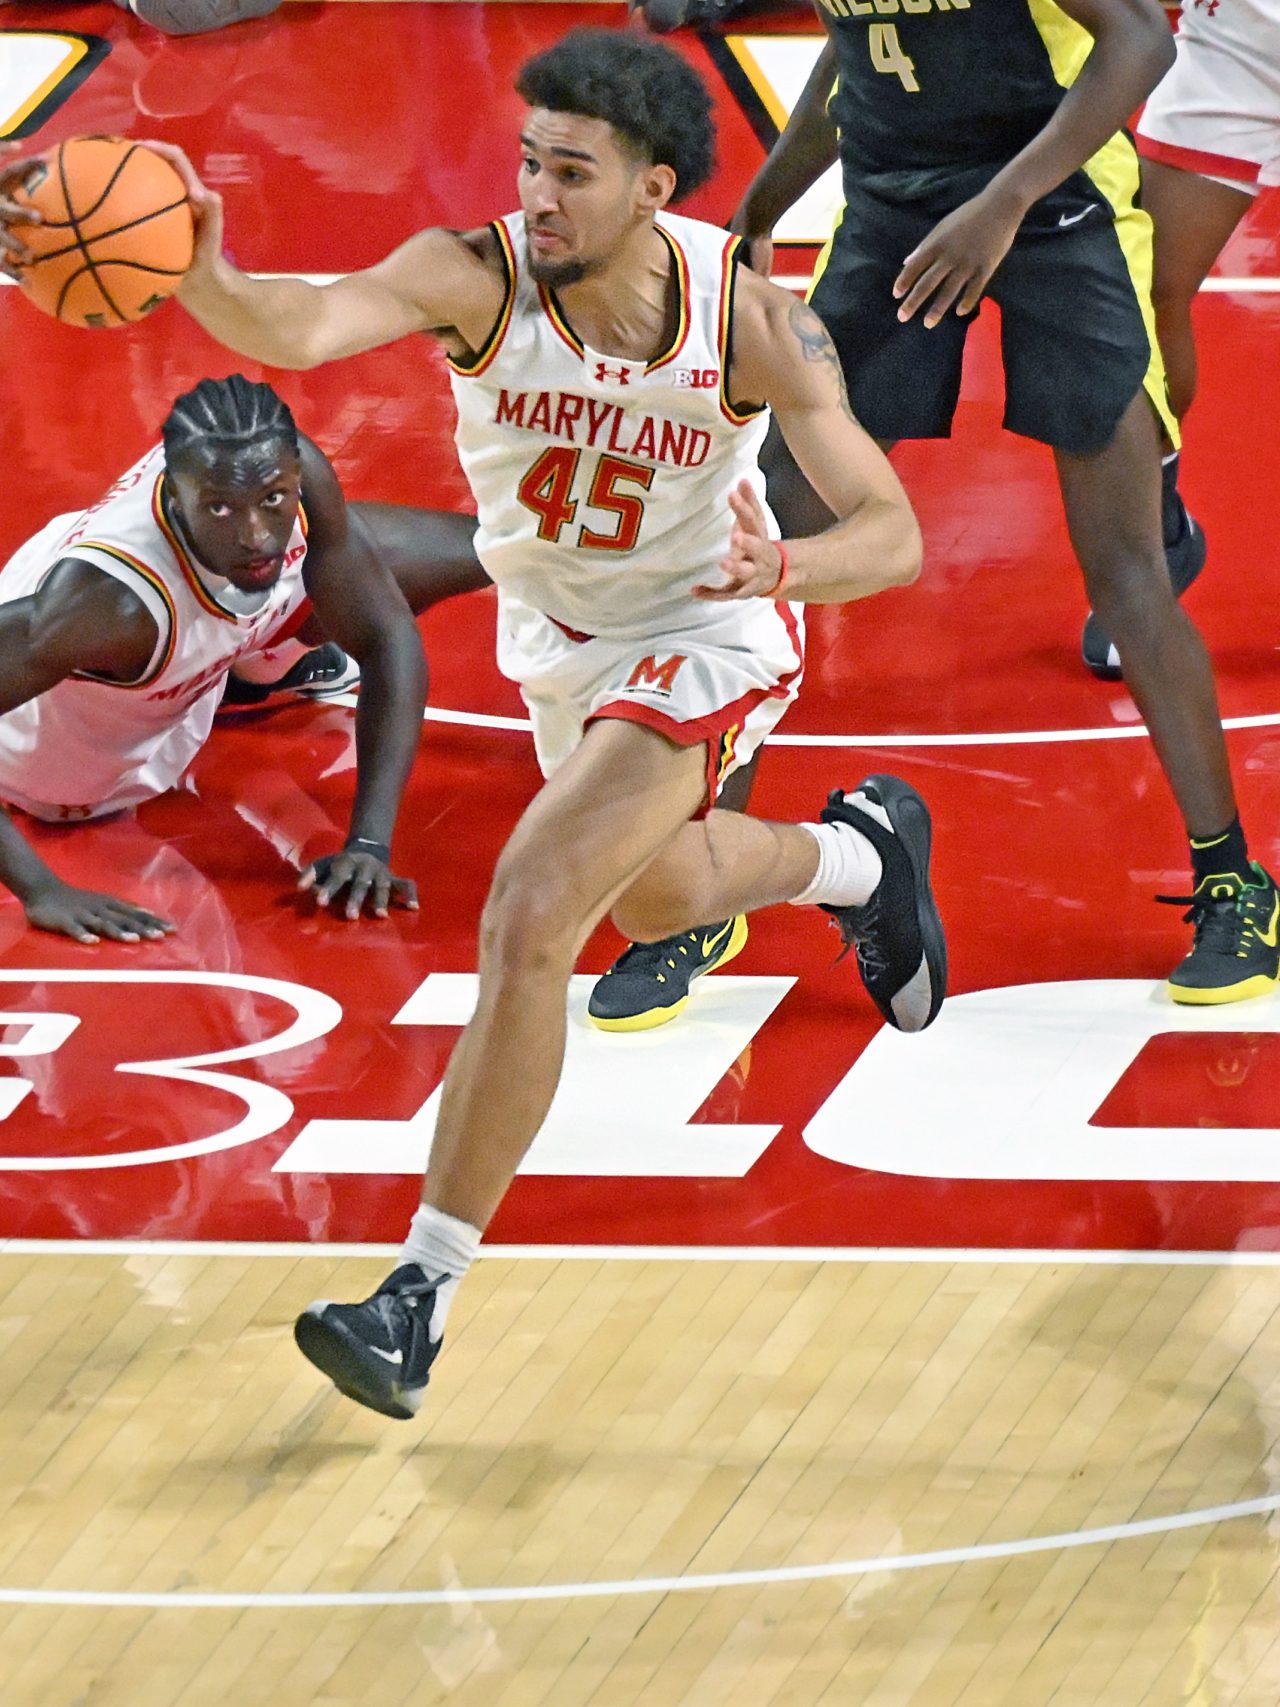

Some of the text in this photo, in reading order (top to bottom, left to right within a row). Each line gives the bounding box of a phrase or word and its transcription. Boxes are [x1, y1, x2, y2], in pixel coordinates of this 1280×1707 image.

[868, 23, 920, 92] 4
[494, 389, 711, 468] MARYLAND
[517, 446, 655, 552] 45
[624, 654, 688, 693] M
